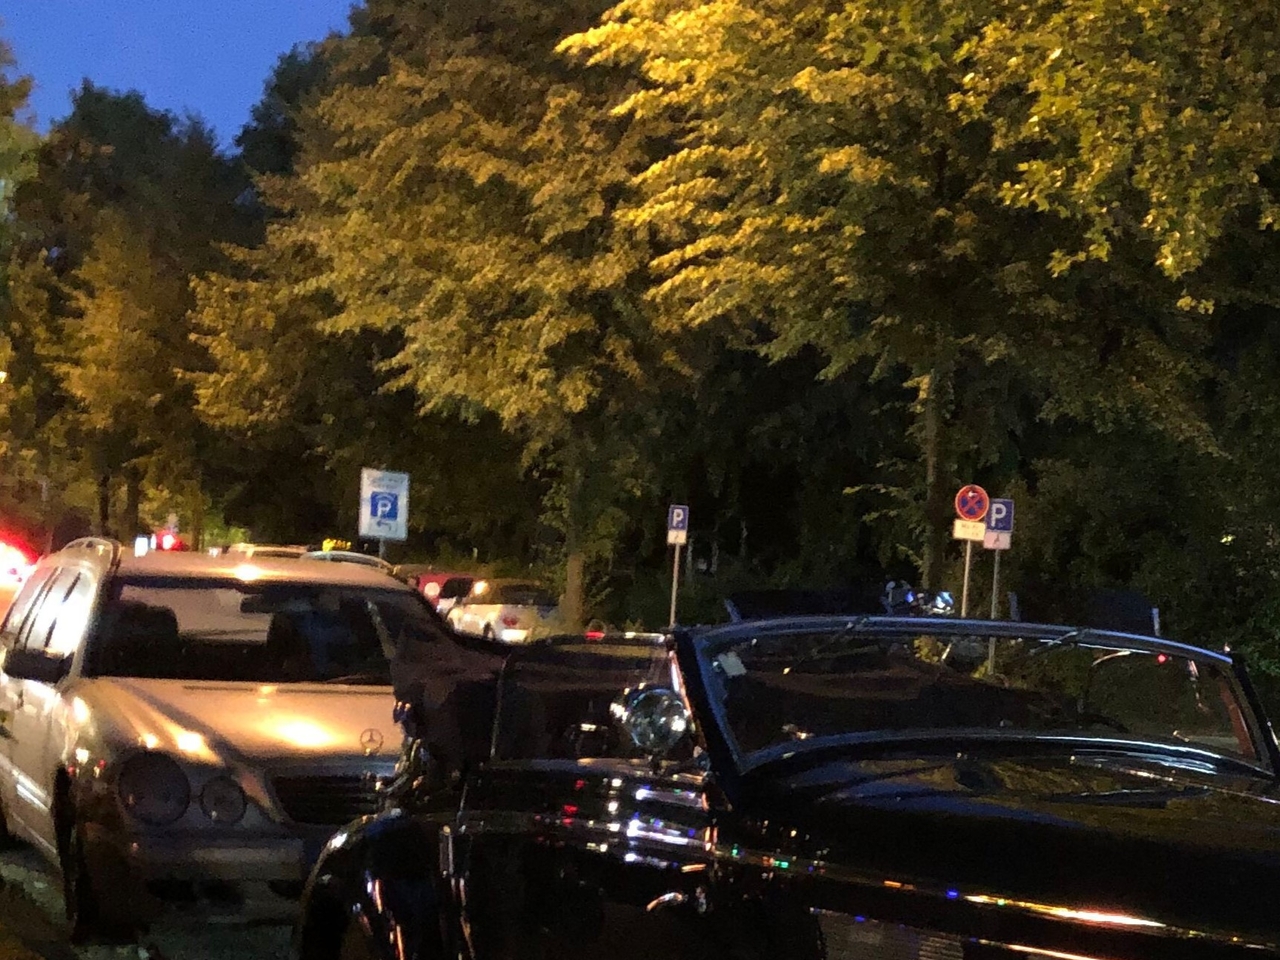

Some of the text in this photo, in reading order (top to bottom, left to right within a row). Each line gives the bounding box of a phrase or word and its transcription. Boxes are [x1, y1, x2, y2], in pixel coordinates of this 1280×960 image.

[377, 501, 391, 517] P
[673, 508, 684, 527] P
[991, 503, 1007, 527] P
